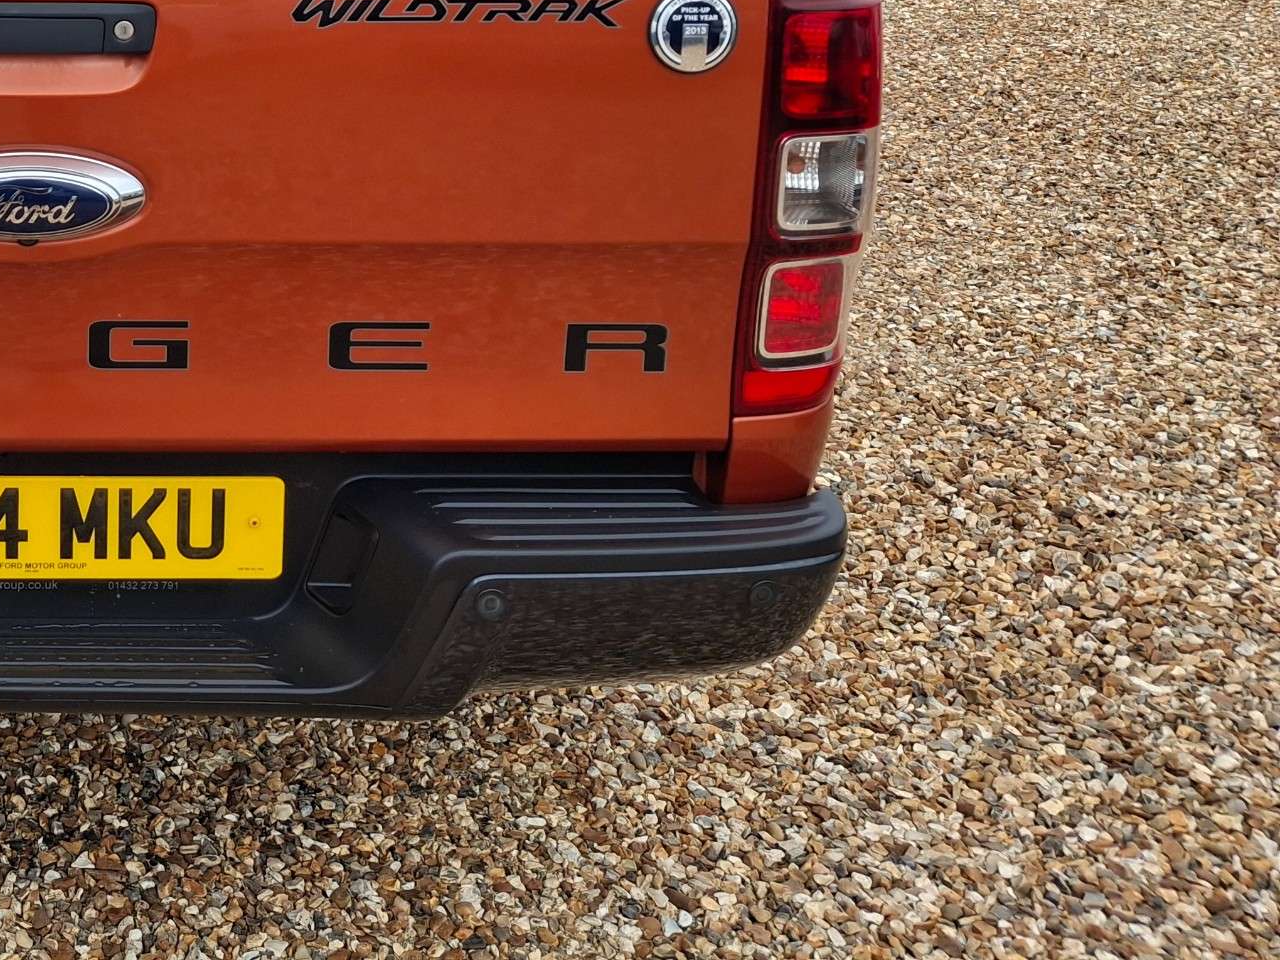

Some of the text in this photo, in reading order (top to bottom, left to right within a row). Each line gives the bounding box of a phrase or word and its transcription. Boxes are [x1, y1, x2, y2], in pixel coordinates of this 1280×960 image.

[60, 487, 226, 560] MKU
[25, 562, 55, 570] MOTOR
[57, 562, 88, 570] GROUP
[108, 581, 179, 590] 01432 273 791
